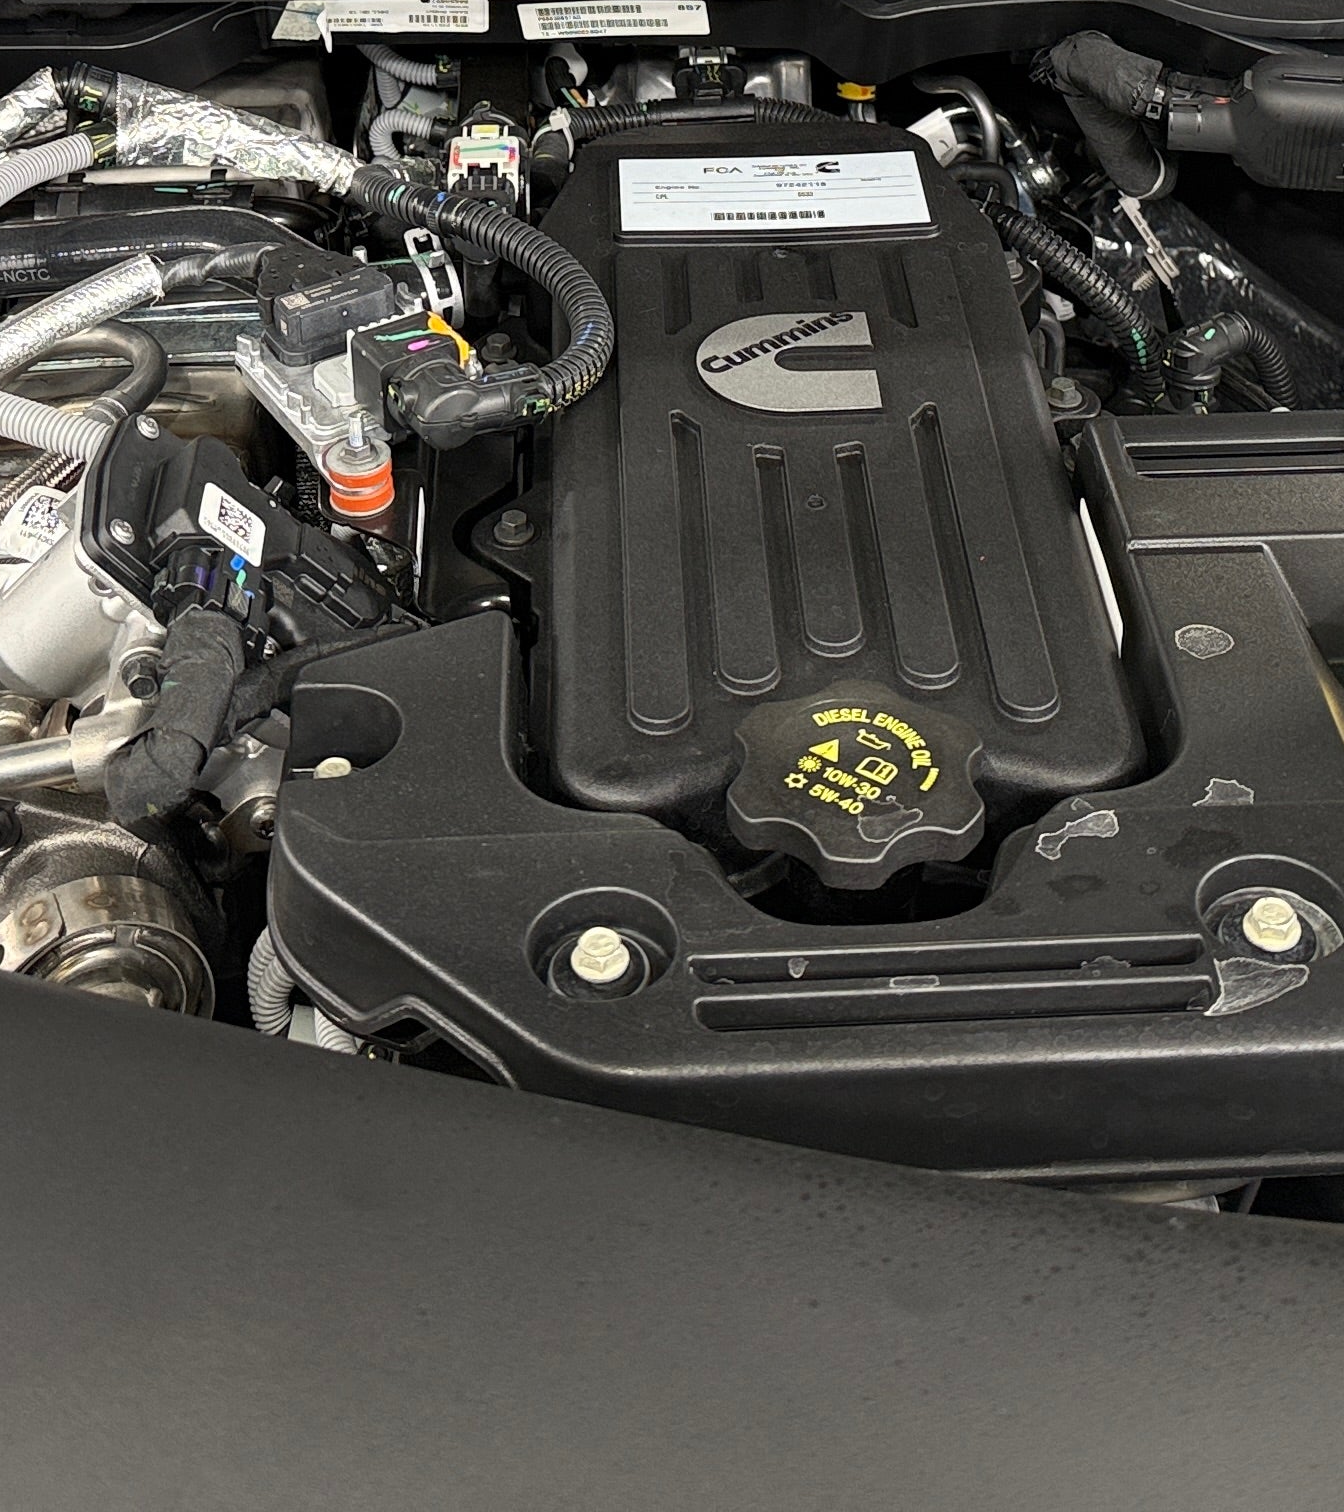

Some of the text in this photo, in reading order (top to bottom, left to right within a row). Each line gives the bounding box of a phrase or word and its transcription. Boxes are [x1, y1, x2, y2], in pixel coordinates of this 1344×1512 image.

[700, 310, 854, 375] Cummins
[812, 708, 932, 770] DIESEL ENGINE OIL
[808, 784, 864, 815] 5W-40
[822, 766, 882, 800] 10W-30
